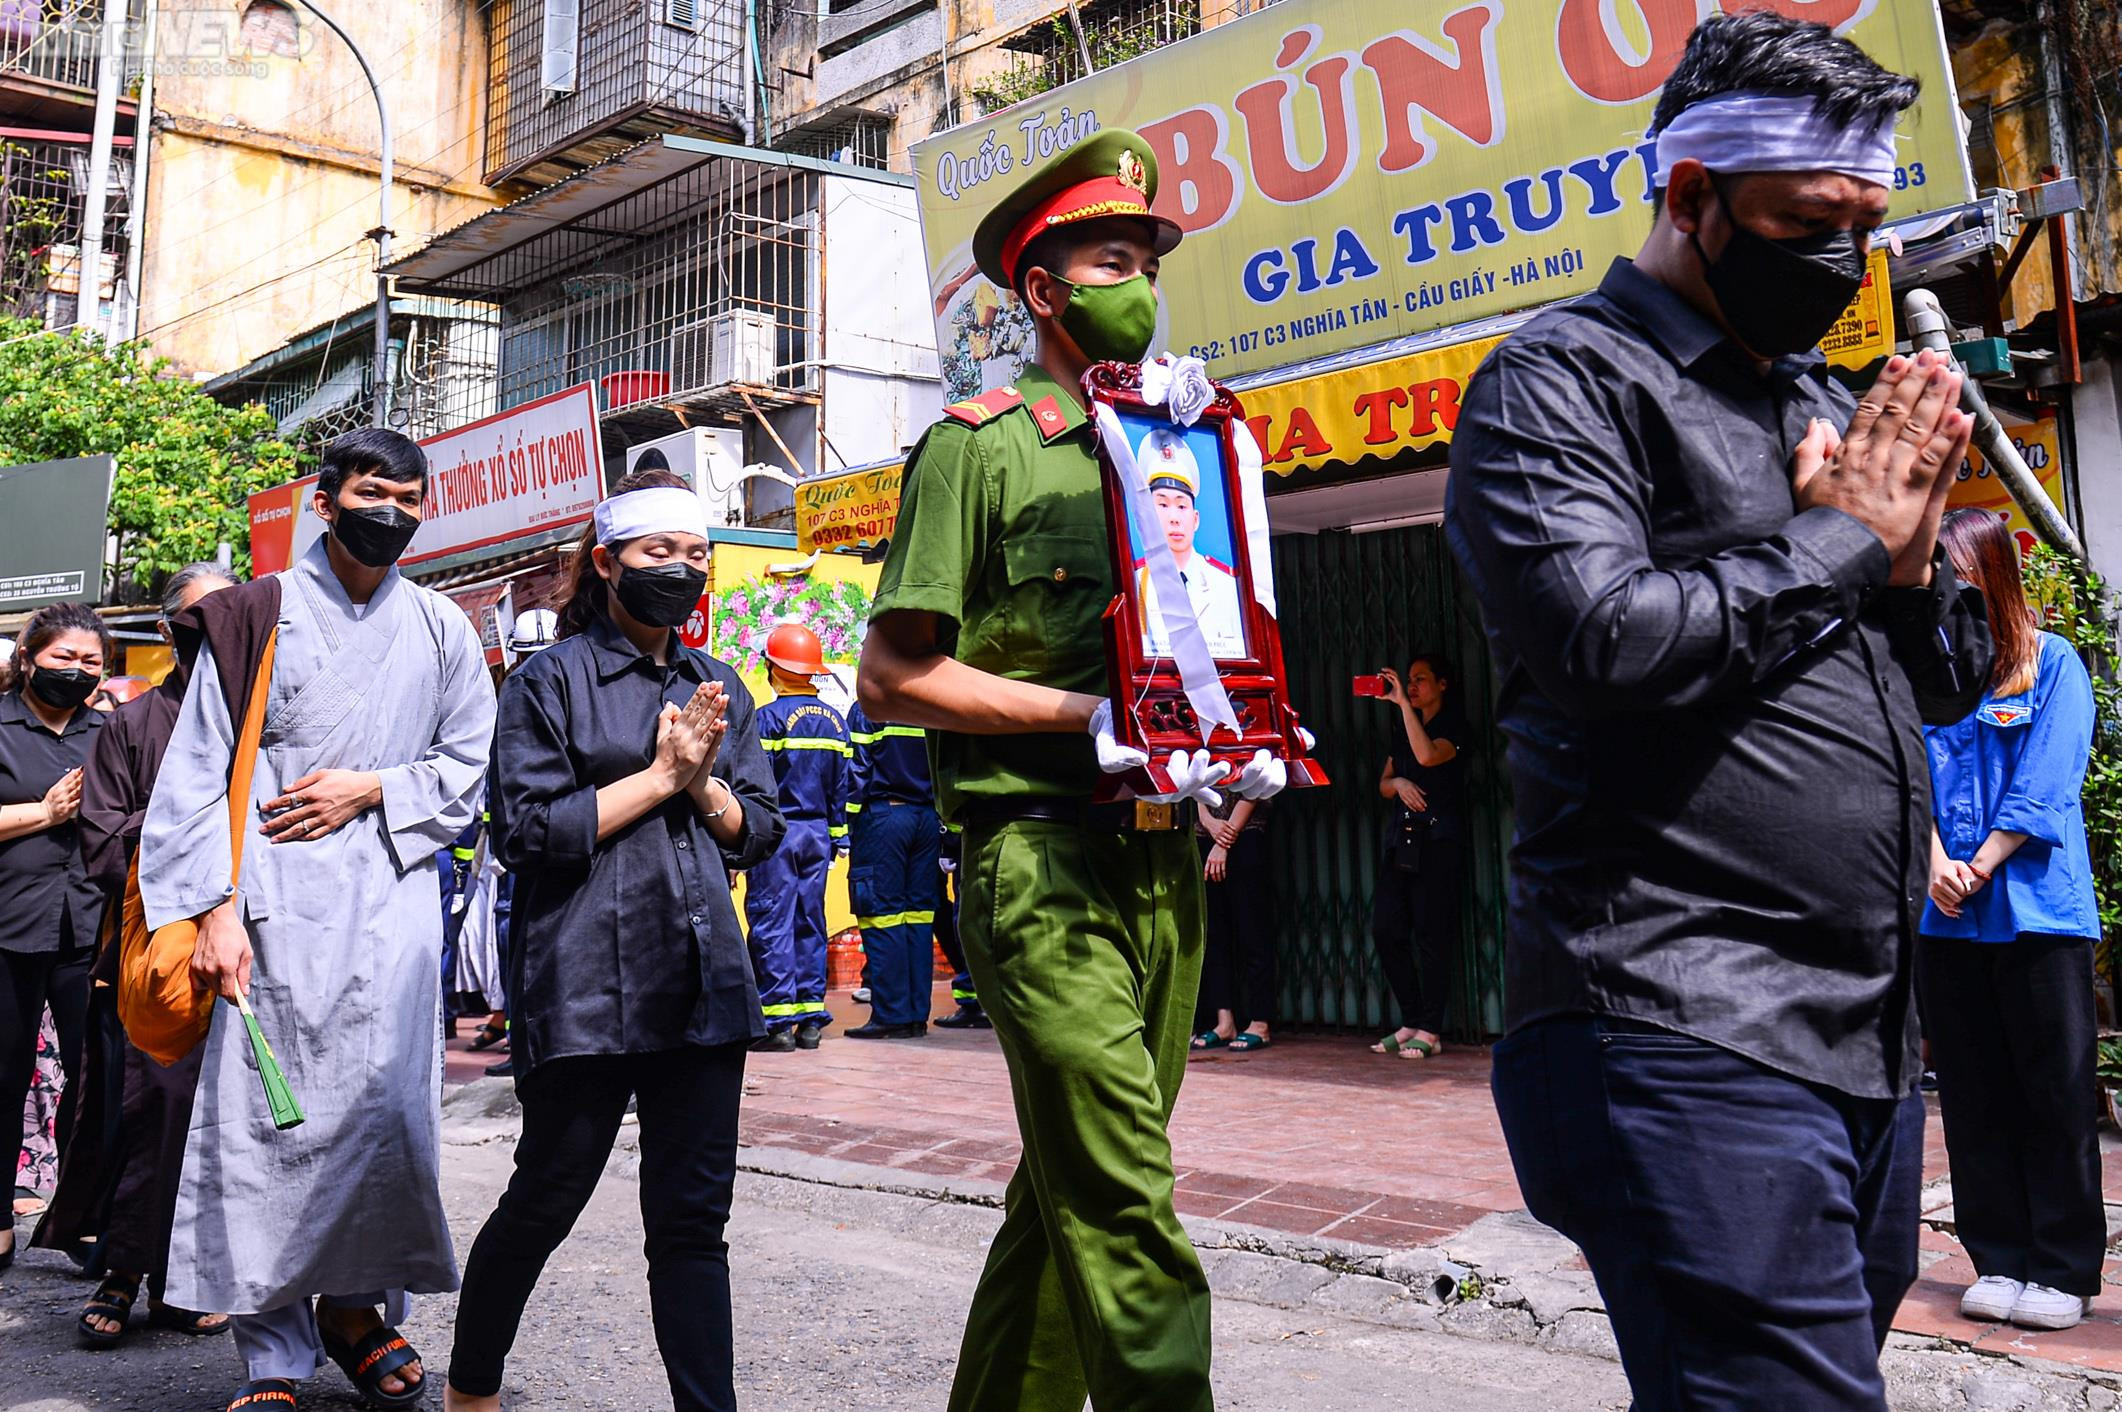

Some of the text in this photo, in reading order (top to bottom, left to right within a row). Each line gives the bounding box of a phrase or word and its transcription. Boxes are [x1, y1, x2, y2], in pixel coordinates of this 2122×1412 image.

[937, 107, 1101, 200] Quốc Toản
[1133, 5, 1500, 234] BÚN
[1189, 340, 1225, 362] Cs2:
[1229, 331, 1259, 354] 107
[1264, 324, 1287, 346] C3
[1290, 308, 1347, 341] NGHĨA
[1350, 298, 1389, 325] TÂN
[1405, 280, 1444, 313] CẦU
[1449, 266, 1496, 301] GIẤY
[1544, 247, 1584, 278] NỘI
[1244, 229, 1379, 302] GIA
[1245, 372, 1475, 465] IA TR
[439, 450, 488, 516] THƯỞNG
[488, 434, 507, 504] XỔ
[509, 429, 527, 497] SỐ
[528, 435, 547, 500] TỰ
[548, 428, 588, 492] CHỌN
[807, 513, 826, 527] 107
[829, 508, 845, 522] C3
[850, 498, 891, 519] NGHĨA
[812, 524, 853, 546] 0332
